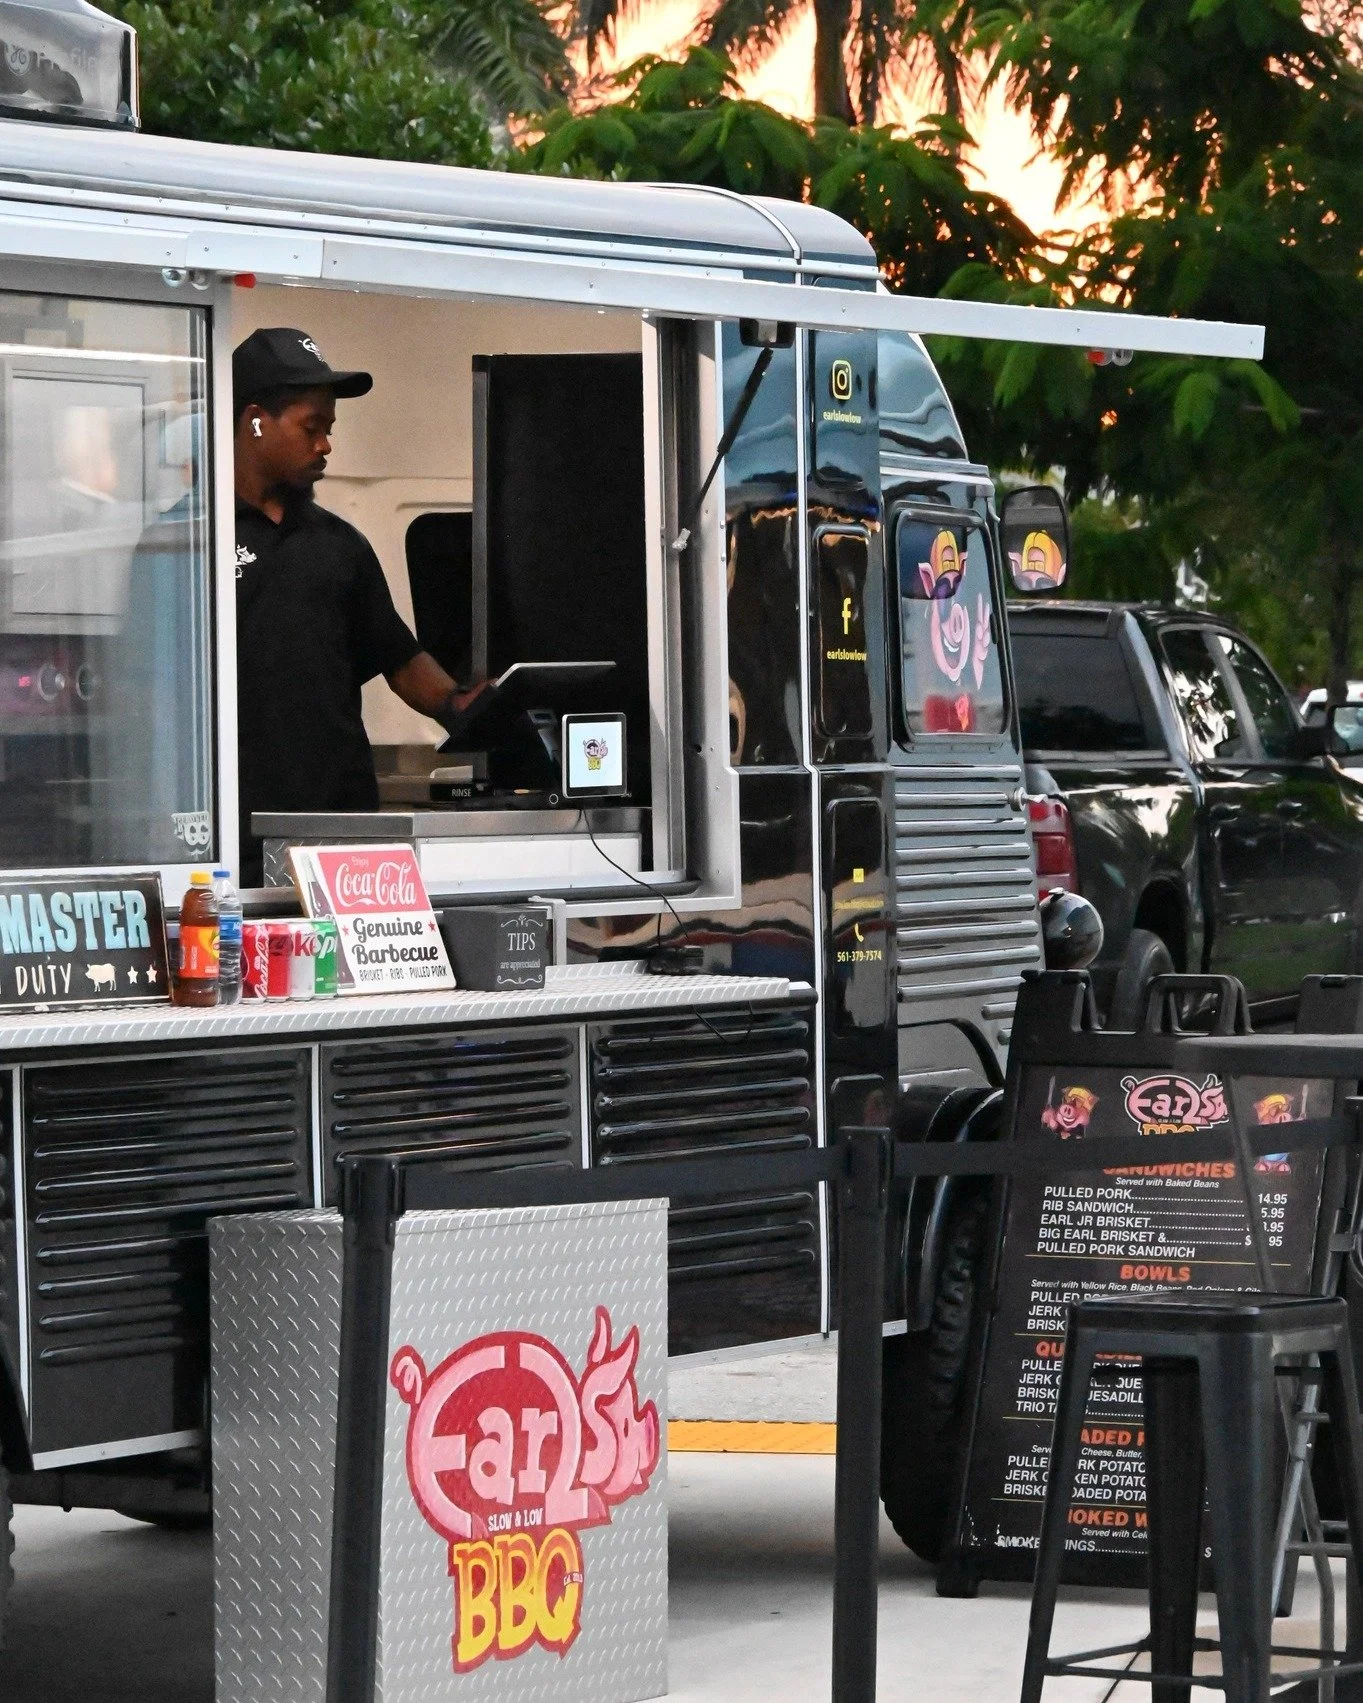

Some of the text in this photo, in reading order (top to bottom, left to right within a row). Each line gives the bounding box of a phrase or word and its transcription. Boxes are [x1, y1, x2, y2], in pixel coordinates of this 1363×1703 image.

[823, 409, 862, 424] earlslowlow
[826, 648, 867, 661] earlslowlow
[452, 788, 472, 797] RINSE
[335, 861, 417, 908] Coca-Cola
[0, 890, 150, 955] MASTER
[353, 917, 424, 944] Genuine
[508, 932, 536, 951] TIPS
[351, 943, 439, 966] Barbecue
[837, 950, 882, 962] 561-379-7574
[15, 963, 72, 996] DUTY
[359, 965, 448, 982] BRISKET RIBS PULLED PORK
[1116, 1177, 1220, 1188] Served with Baked Beans
[1044, 1186, 1093, 1199] PULLED
[1096, 1188, 1133, 1200] PORK
[1042, 1200, 1064, 1212] RIB
[1066, 1202, 1134, 1214] SANDWICH
[1040, 1213, 1074, 1226] EARL
[1076, 1215, 1093, 1227] JR
[1096, 1217, 1151, 1229] BRISKET
[1038, 1227, 1061, 1239] BIG
[1063, 1228, 1097, 1241] EARL
[1100, 1230, 1155, 1243] BRISKET
[1036, 1241, 1196, 1258] PULLED PORK SANDWICH
[1120, 1264, 1191, 1281] BOWLS
[1030, 1278, 1060, 1288] Served
[1061, 1280, 1079, 1289] with
[1080, 1281, 1107, 1290] Yellow
[1130, 1283, 1154, 1292] Black
[1028, 1305, 1062, 1317] JERK
[1027, 1319, 1066, 1331] BRISK
[1021, 1359, 1062, 1372] PULLE
[1019, 1373, 1053, 1386] JERK
[1017, 1387, 1060, 1400] BRISK
[1016, 1400, 1045, 1413] TRIO
[1081, 1428, 1132, 1446] ADED
[1081, 1447, 1114, 1458] Cheese,
[1007, 1455, 1049, 1468] PULLE
[1078, 1459, 1097, 1471] RK
[1005, 1469, 1038, 1481] JERK
[1003, 1483, 1047, 1497] BRISKE
[487, 1507, 544, 1532] SLOW & LOW
[1068, 1509, 1129, 1527] OKED
[1081, 1527, 1110, 1538] Served
[1112, 1530, 1130, 1538] with
[996, 1535, 1096, 1552] SMOKE INGS
[453, 1527, 580, 1664] BBQ
